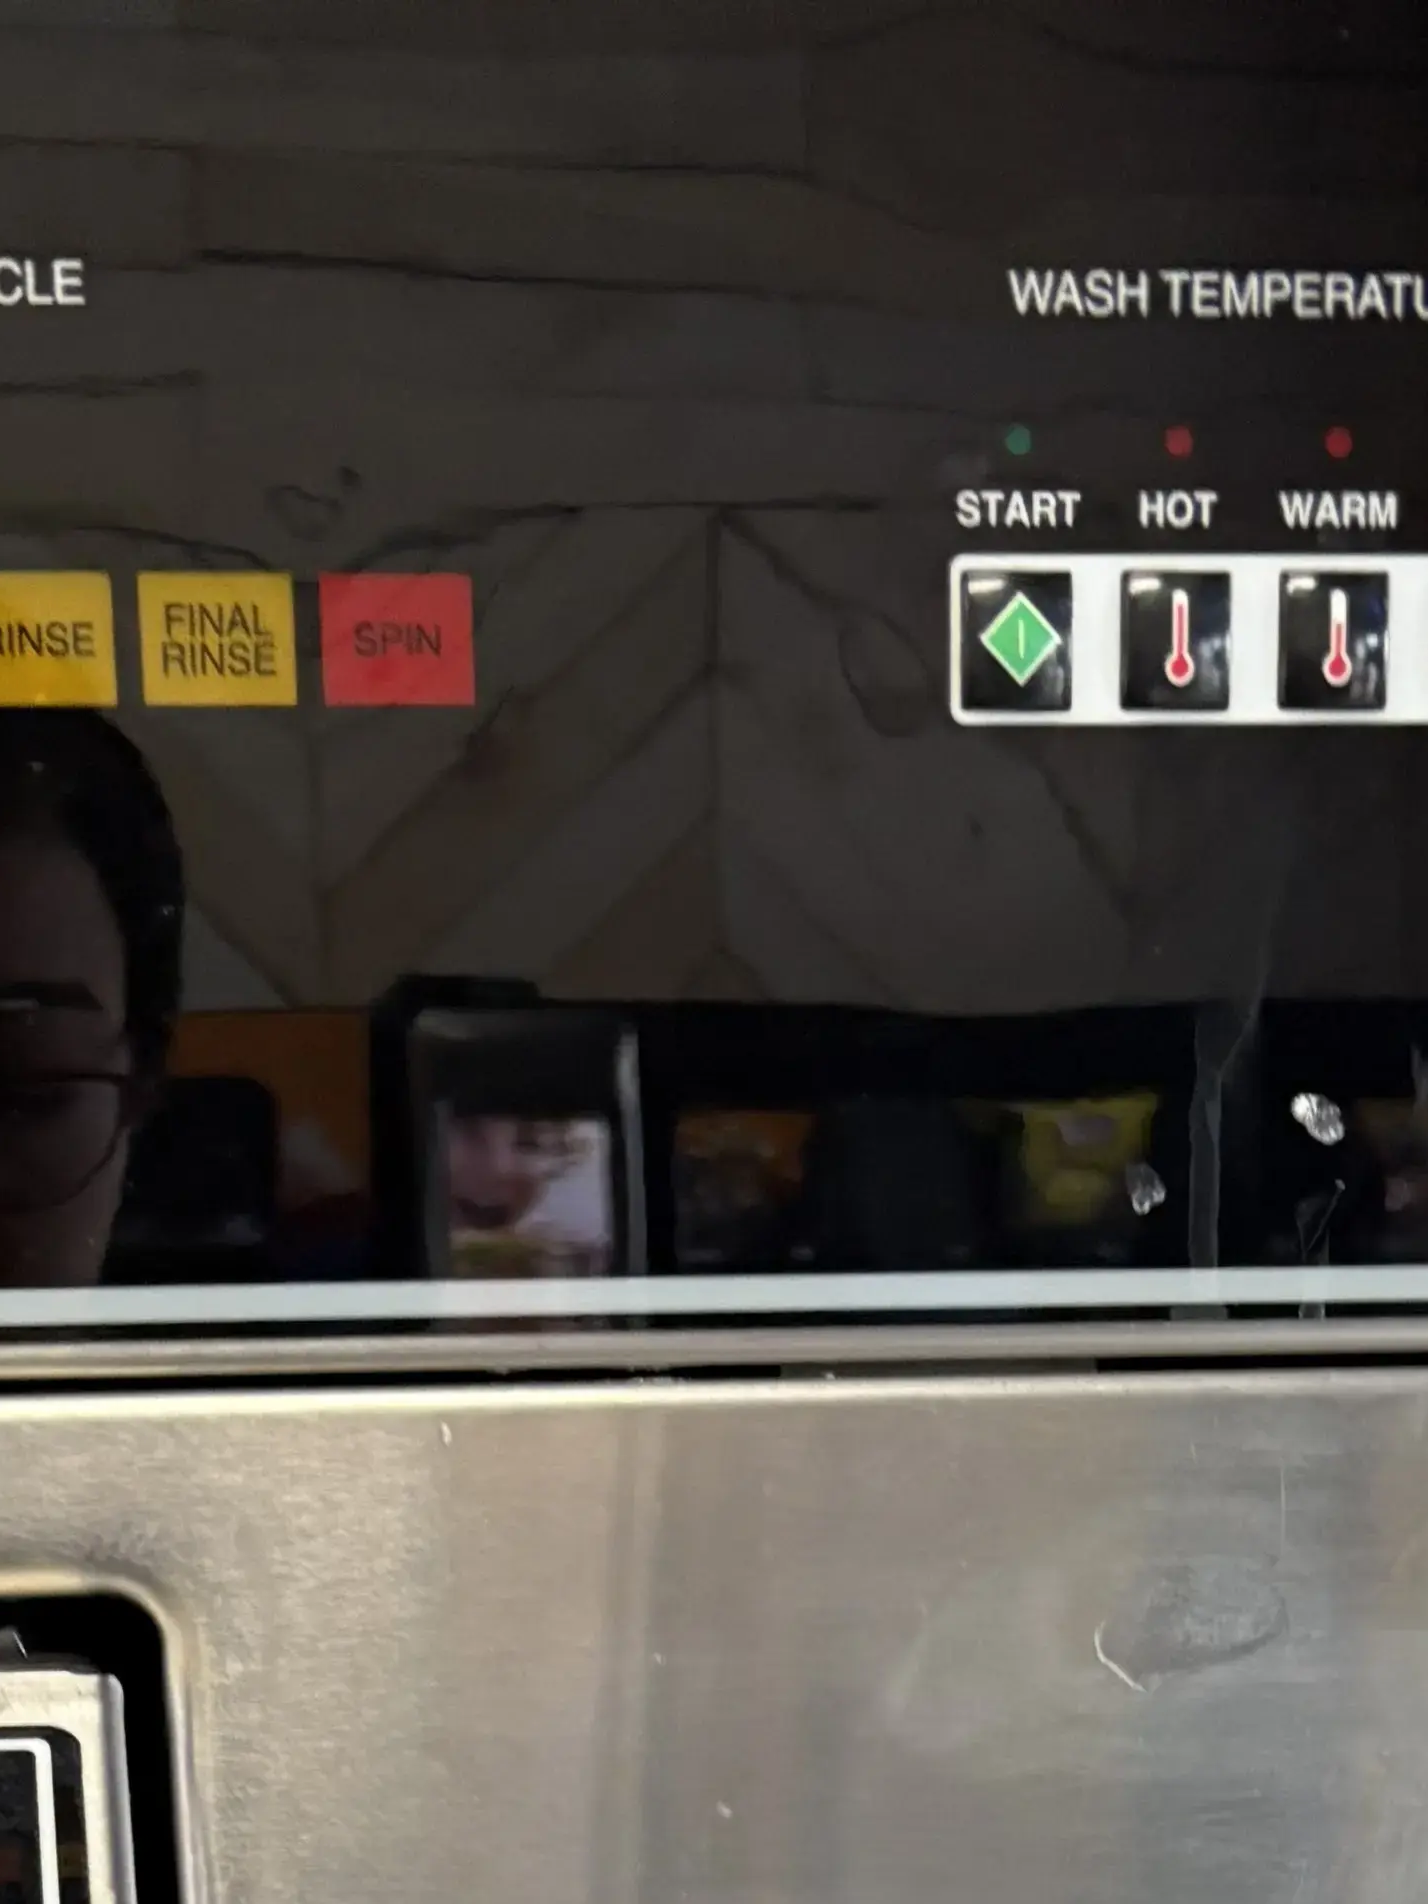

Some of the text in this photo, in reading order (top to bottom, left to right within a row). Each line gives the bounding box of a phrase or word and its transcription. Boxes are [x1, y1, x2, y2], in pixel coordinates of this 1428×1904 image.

[1008, 269, 1148, 317] WASH
[956, 490, 1081, 528] START
[1139, 491, 1217, 527] HOT
[1280, 491, 1398, 528] WARM
[164, 603, 270, 638] FINAL
[353, 622, 442, 657] SPIN
[162, 640, 277, 678] RINSE
